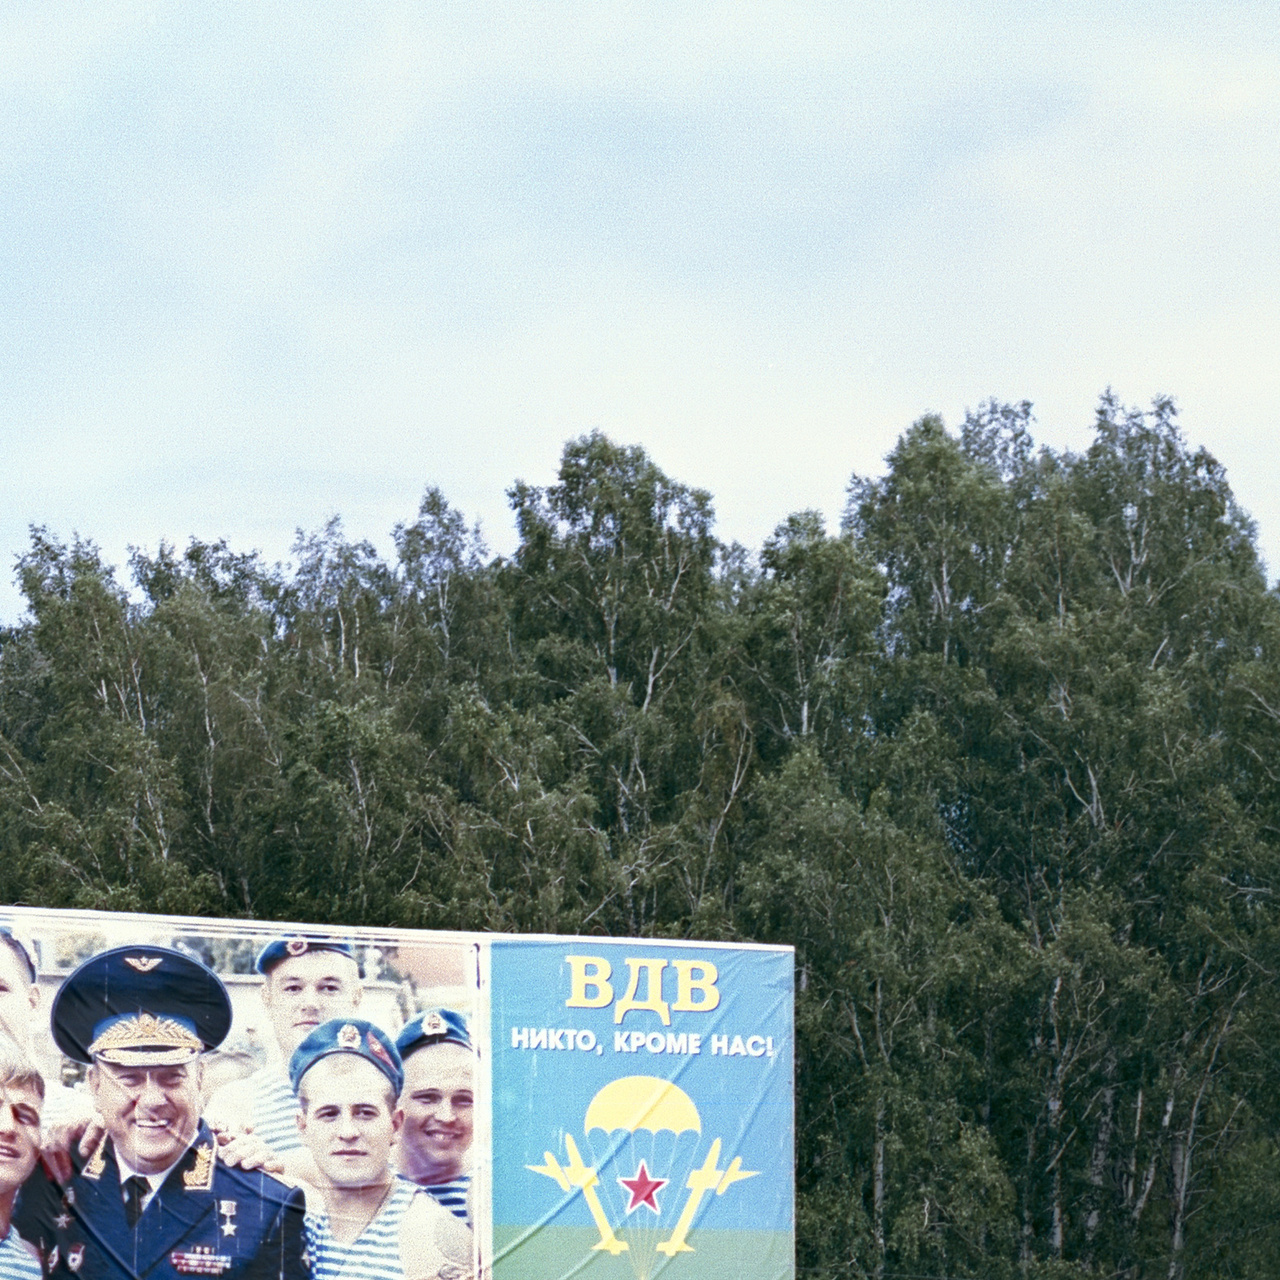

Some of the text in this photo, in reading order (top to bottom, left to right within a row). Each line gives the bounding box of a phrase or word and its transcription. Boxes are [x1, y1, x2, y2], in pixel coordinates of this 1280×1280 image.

[566, 955, 720, 1026] ВДВ
[511, 1027, 776, 1057] НИКТО, КРОМЕ НАС!
